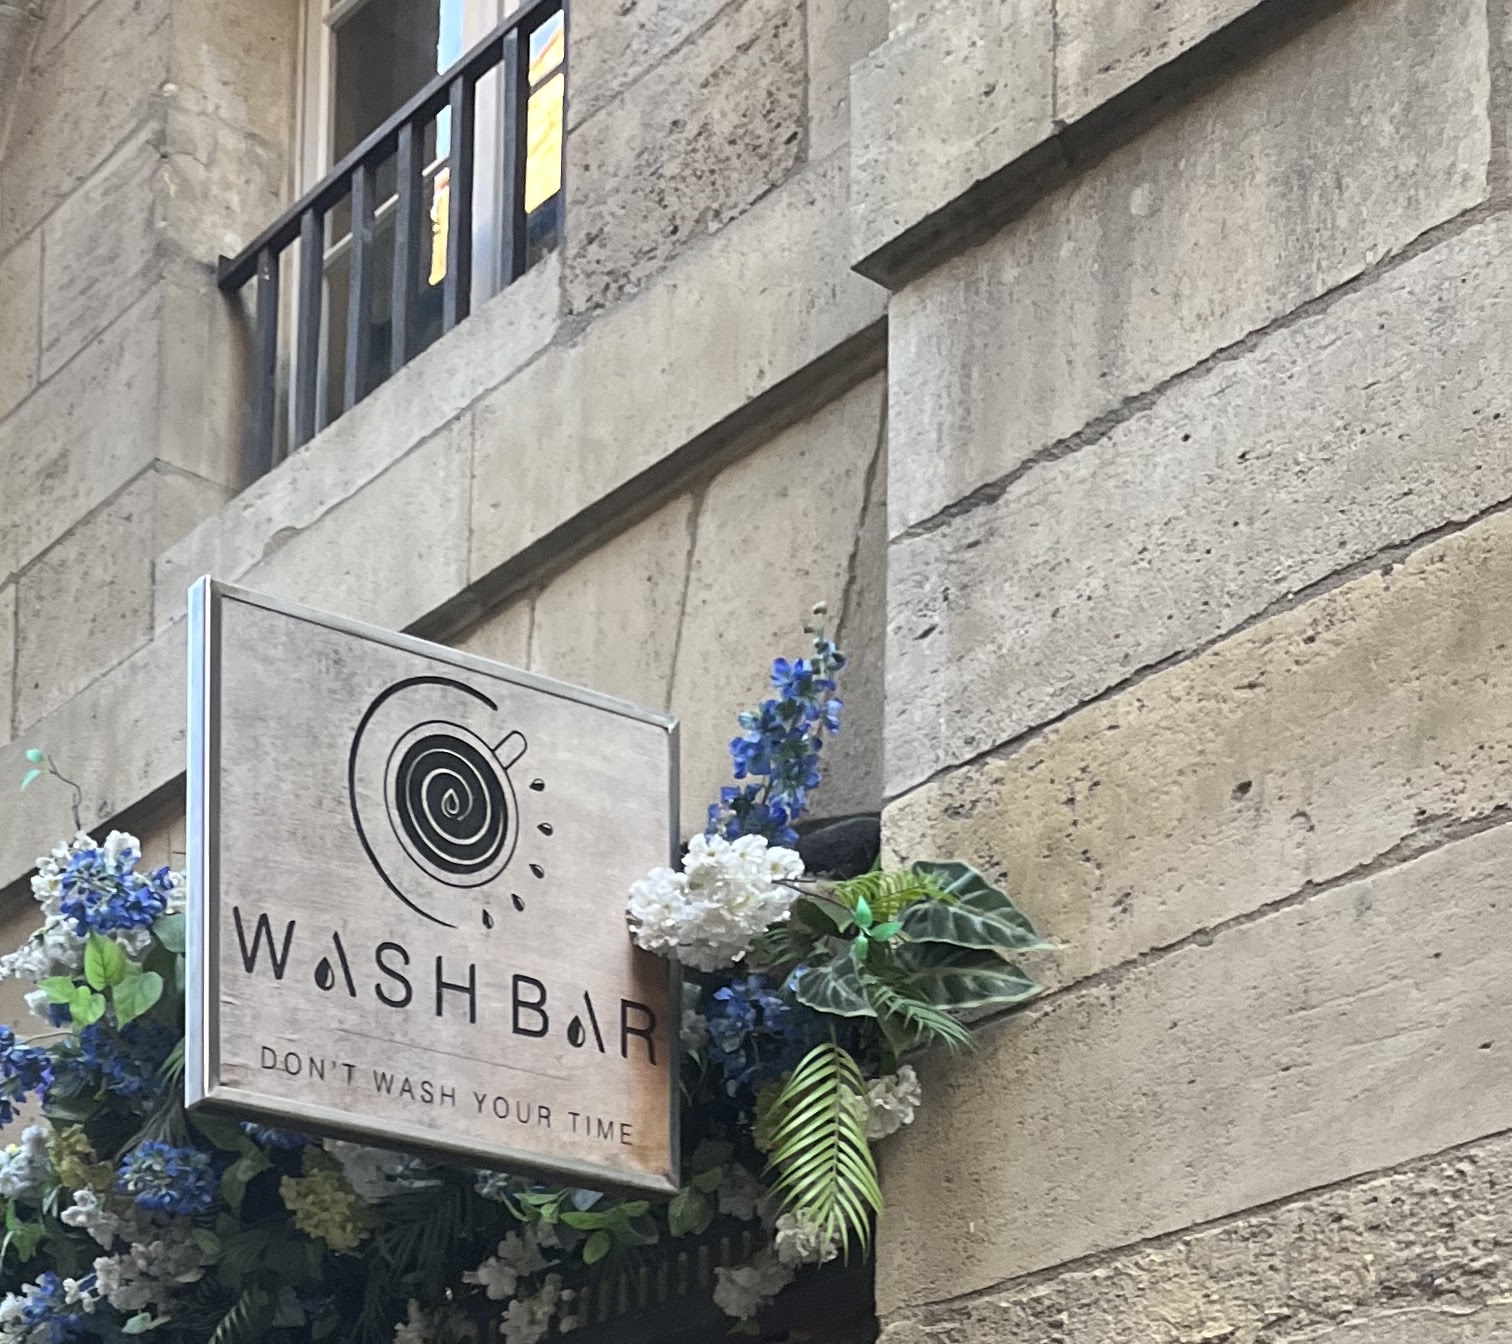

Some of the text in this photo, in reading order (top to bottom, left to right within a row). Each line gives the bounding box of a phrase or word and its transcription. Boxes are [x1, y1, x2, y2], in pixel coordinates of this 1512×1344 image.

[260, 1045, 634, 1147] DON'T WASH YOUR TIME
